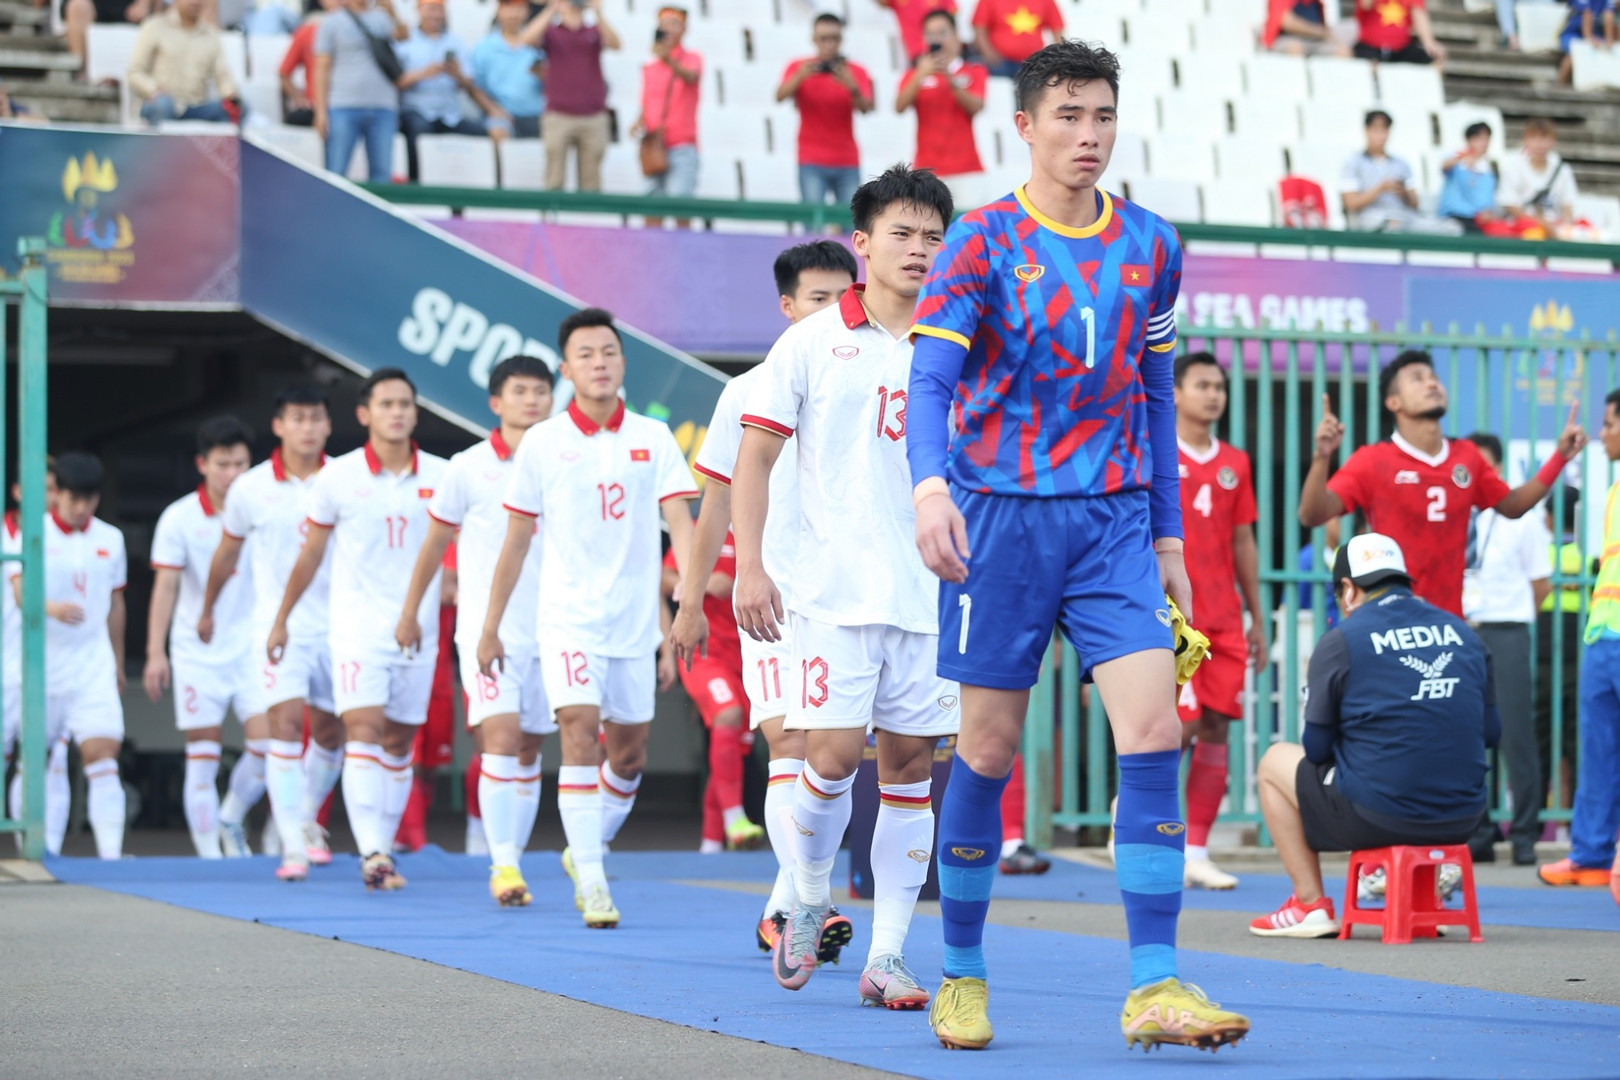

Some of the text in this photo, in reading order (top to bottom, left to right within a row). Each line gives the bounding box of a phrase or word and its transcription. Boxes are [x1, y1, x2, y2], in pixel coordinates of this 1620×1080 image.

[1194, 292, 1256, 330] SEA
[1259, 294, 1370, 334] GAMES
[1081, 306, 1095, 369] 1
[877, 386, 907, 442] 13
[598, 482, 625, 521] 12
[1193, 483, 1213, 518] 4
[1427, 486, 1447, 522] 2
[386, 516, 409, 549] 17
[958, 593, 972, 655] 1
[1370, 624, 1464, 655] MEDIA
[340, 661, 362, 693] 17
[476, 668, 499, 704] 18
[561, 651, 590, 687] 12
[758, 657, 782, 702] 11
[802, 656, 829, 709] 13
[1410, 677, 1461, 701] FBT
